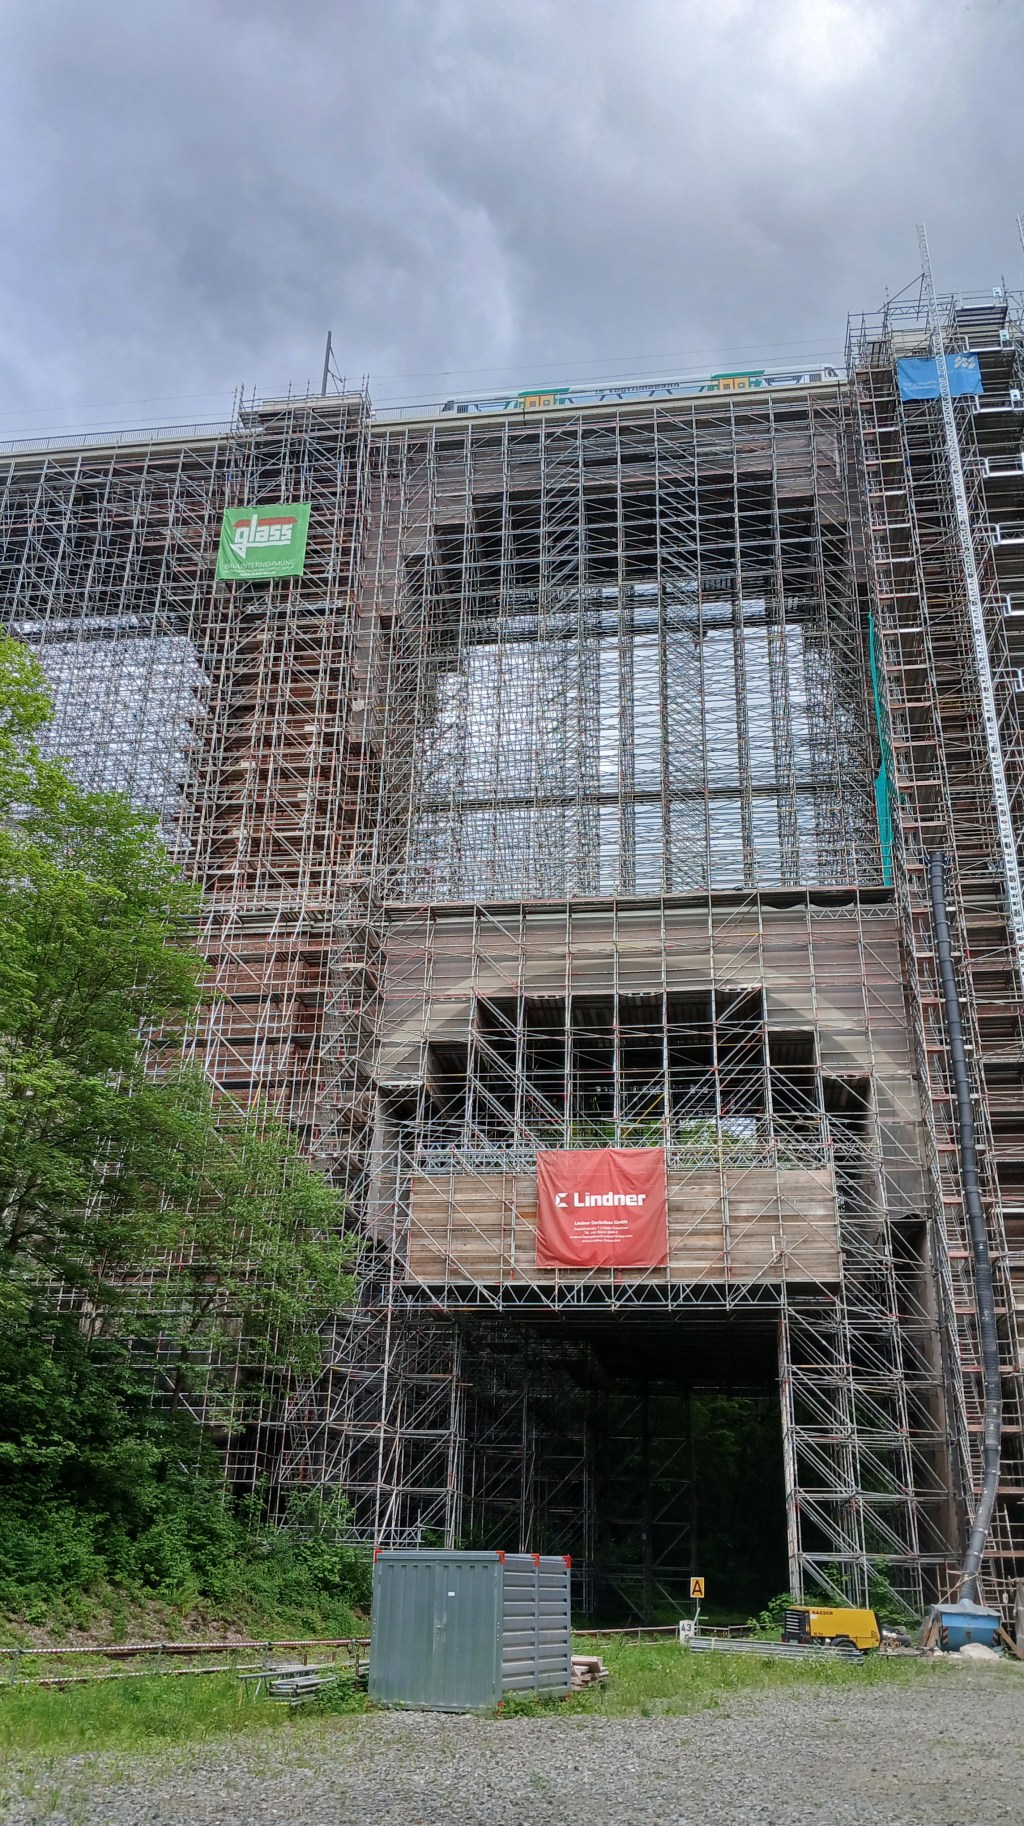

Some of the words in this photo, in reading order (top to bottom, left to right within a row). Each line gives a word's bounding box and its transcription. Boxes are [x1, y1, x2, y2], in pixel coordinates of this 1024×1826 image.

[229, 514, 293, 559] glass
[224, 560, 295, 569] BAUUNTERNEHMUNG
[573, 1191, 646, 1207] Lindner
[691, 1580, 703, 1595] A
[681, 1623, 692, 1632] 43
